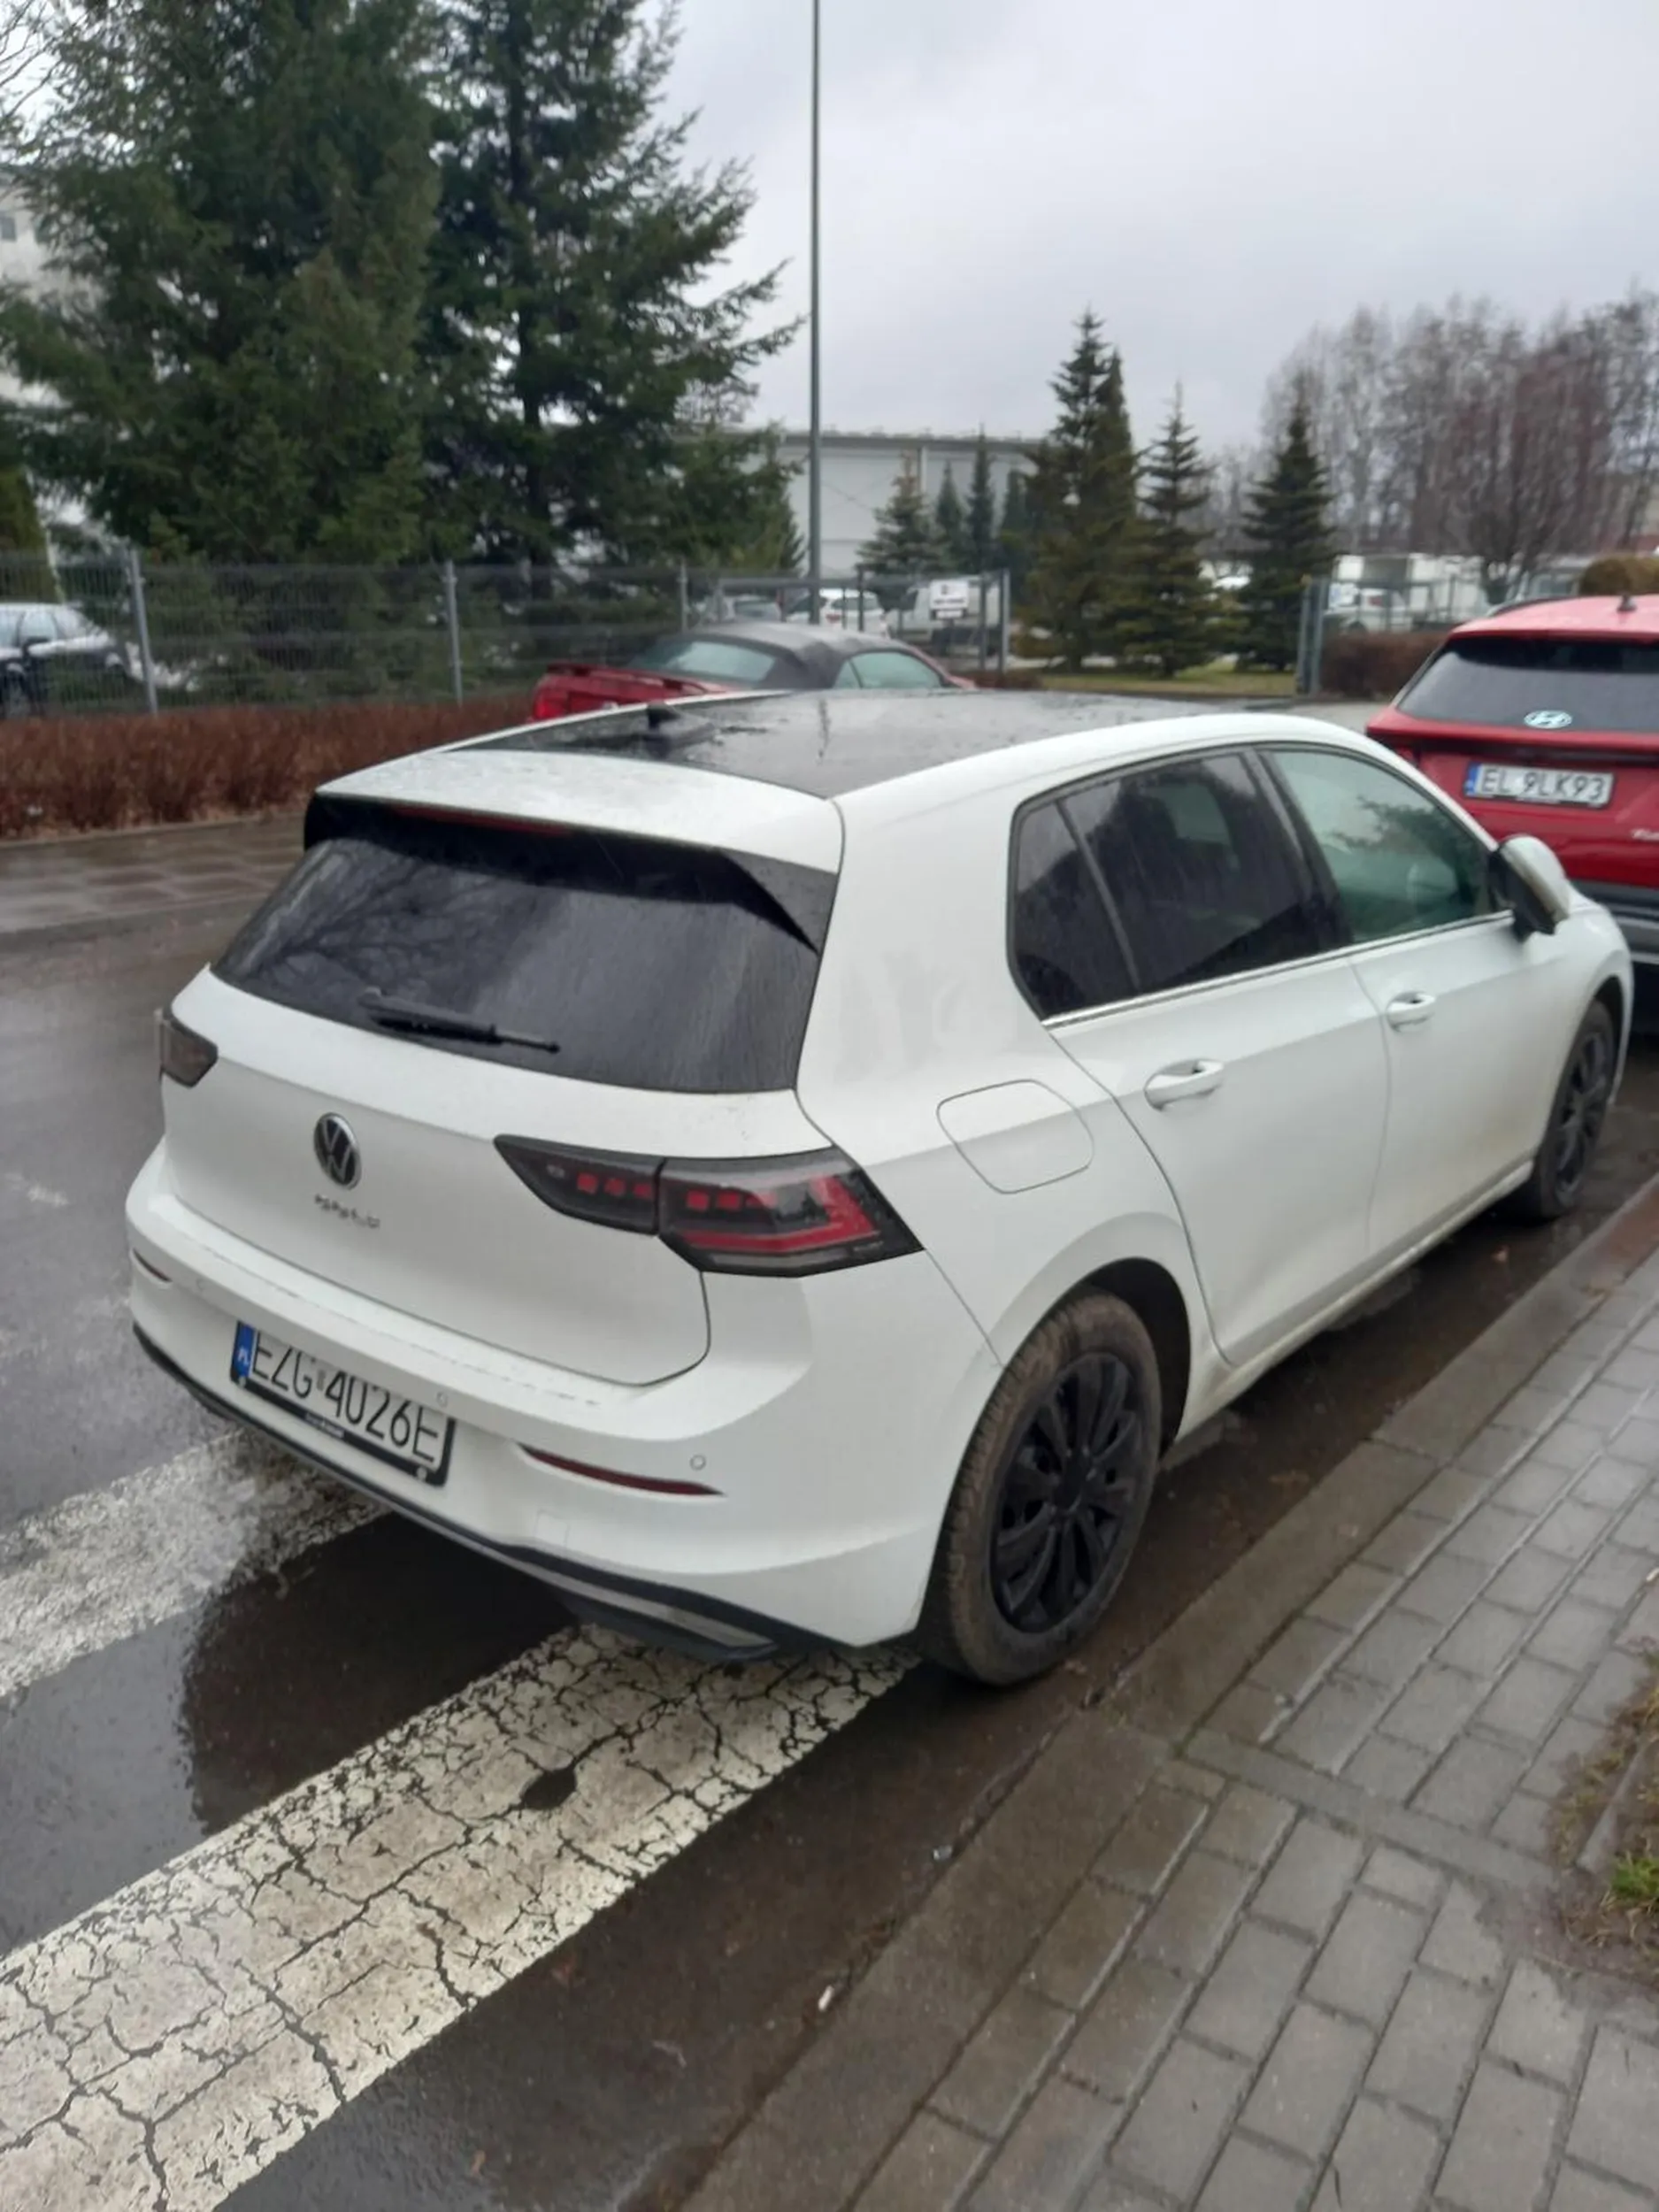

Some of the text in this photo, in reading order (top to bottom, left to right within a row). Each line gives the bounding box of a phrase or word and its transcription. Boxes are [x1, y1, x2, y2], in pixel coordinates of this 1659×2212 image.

[1481, 768, 1605, 802] EL 9LK93
[252, 1330, 439, 1463] EZG 4026E
